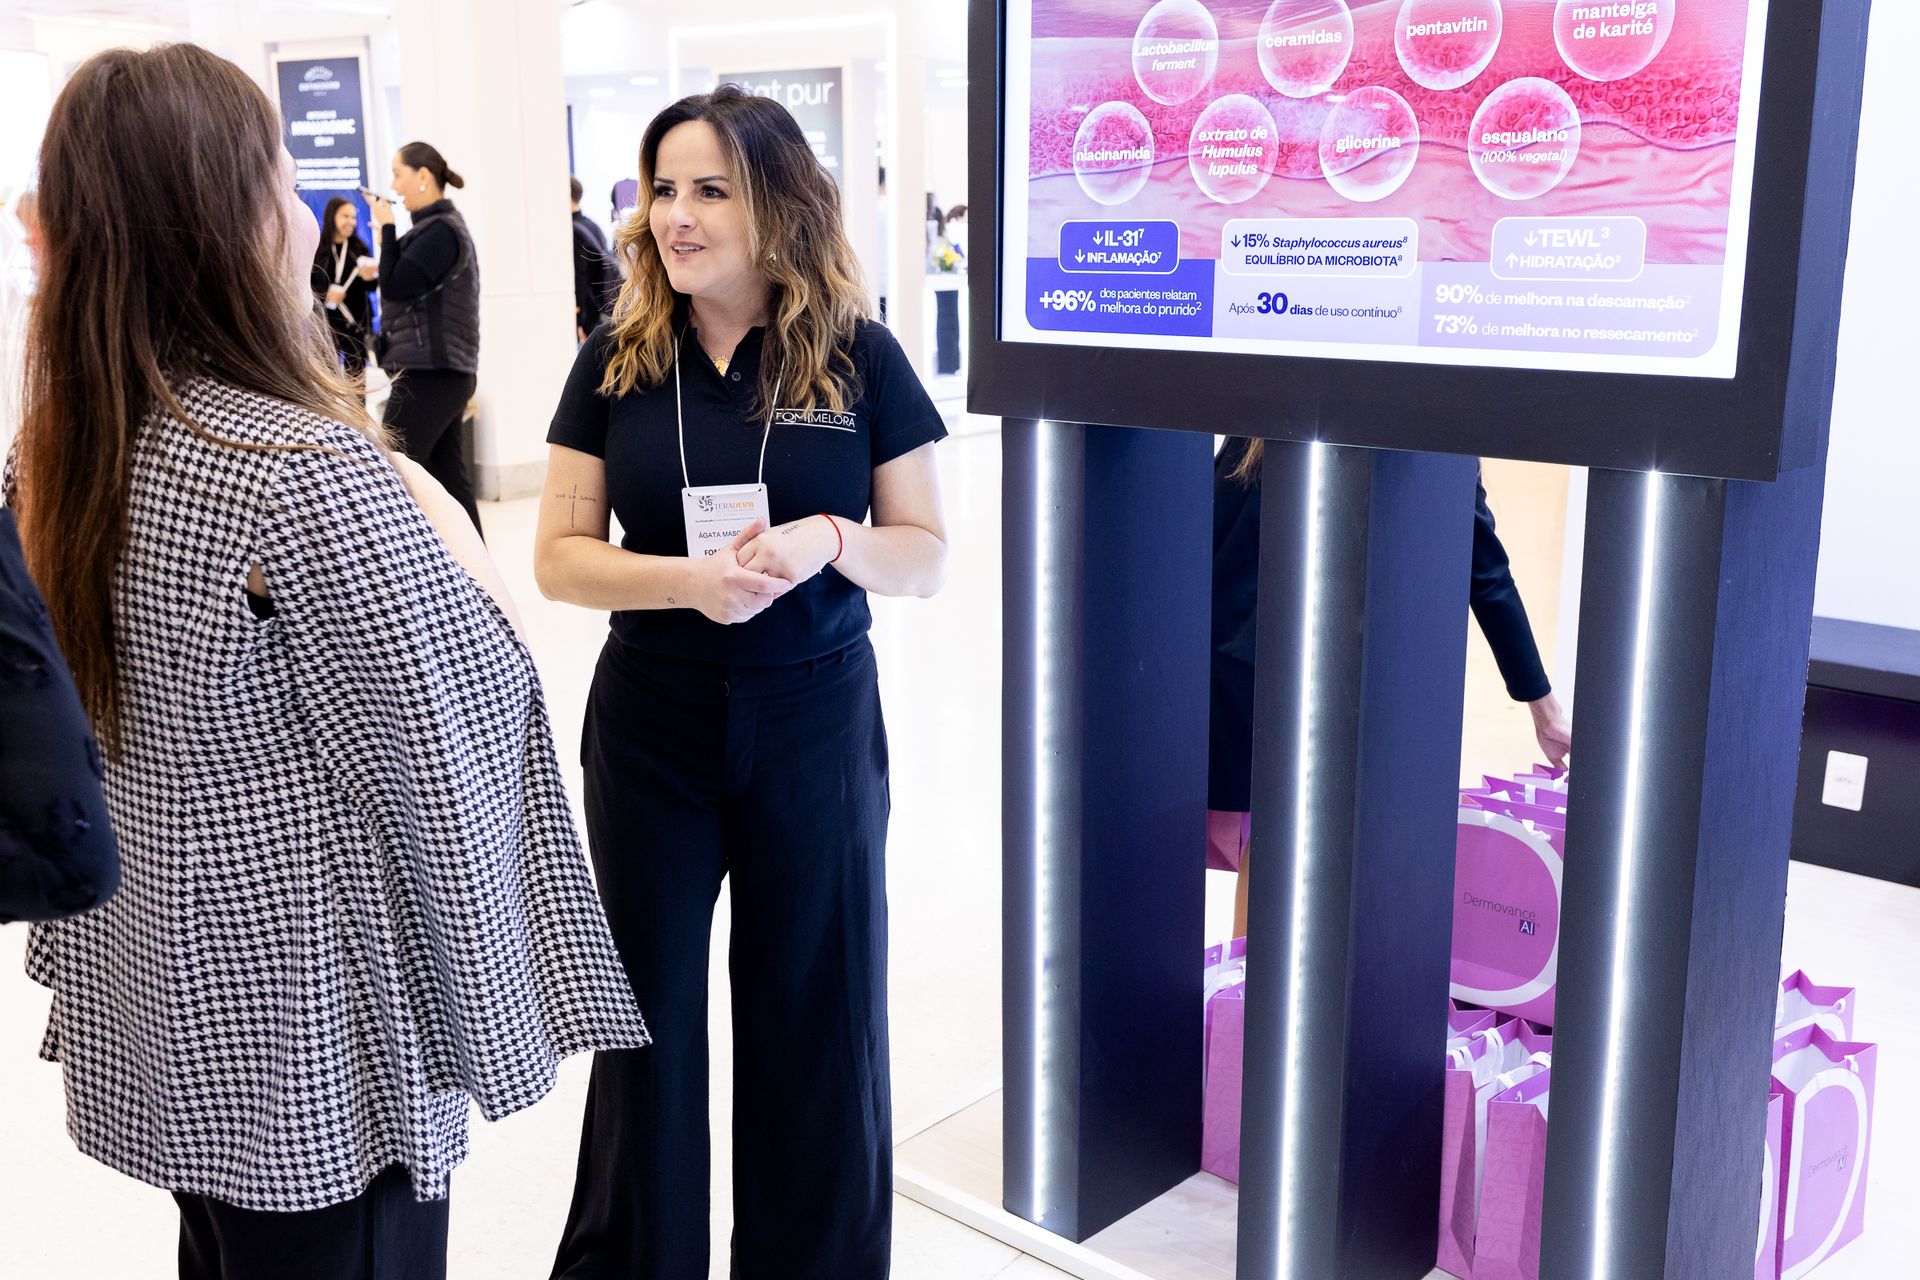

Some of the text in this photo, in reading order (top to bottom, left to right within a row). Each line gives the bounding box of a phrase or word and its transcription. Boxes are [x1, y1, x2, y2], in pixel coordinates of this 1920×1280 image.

[1572, 0, 1658, 21] manteiga
[1406, 17, 1488, 39] pentavitin
[1573, 18, 1654, 40] de karité
[1134, 39, 1216, 57] Lactobacillus
[1265, 30, 1342, 48] ceramidas
[1152, 58, 1196, 71] ferment
[786, 82, 834, 113] pur
[1199, 126, 1268, 142] extrato de
[1481, 127, 1569, 147] esqualano
[1201, 143, 1263, 159] Humulus
[1336, 134, 1401, 153] glicerina
[1077, 146, 1150, 162] niacinamida
[1480, 149, 1568, 165] (100% vegetal)
[1208, 160, 1258, 178] lupulus
[1242, 233, 1270, 248] 15%
[1272, 236, 1361, 250] Staphylococcus
[1245, 252, 1305, 266] EQUILÍBRIO
[1307, 255, 1323, 266] DA
[1039, 289, 1097, 312] +96%
[1100, 288, 1198, 303] dos pacientes relatam
[1228, 302, 1255, 316] Após
[1257, 291, 1289, 315] 30
[1290, 304, 1313, 316] dias
[1314, 304, 1329, 317] de
[1330, 308, 1349, 317] uso
[1435, 284, 1484, 305] 90%
[1485, 291, 1502, 305] de
[1504, 292, 1564, 307] melhora
[1565, 296, 1585, 307] na
[1100, 302, 1142, 315] melhora
[1143, 302, 1157, 315] do
[1434, 314, 1478, 335] 73%
[1481, 322, 1499, 336] de
[1501, 323, 1561, 338] melhora
[1562, 328, 1581, 339] no
[1463, 891, 1536, 936] Dermovance AI
